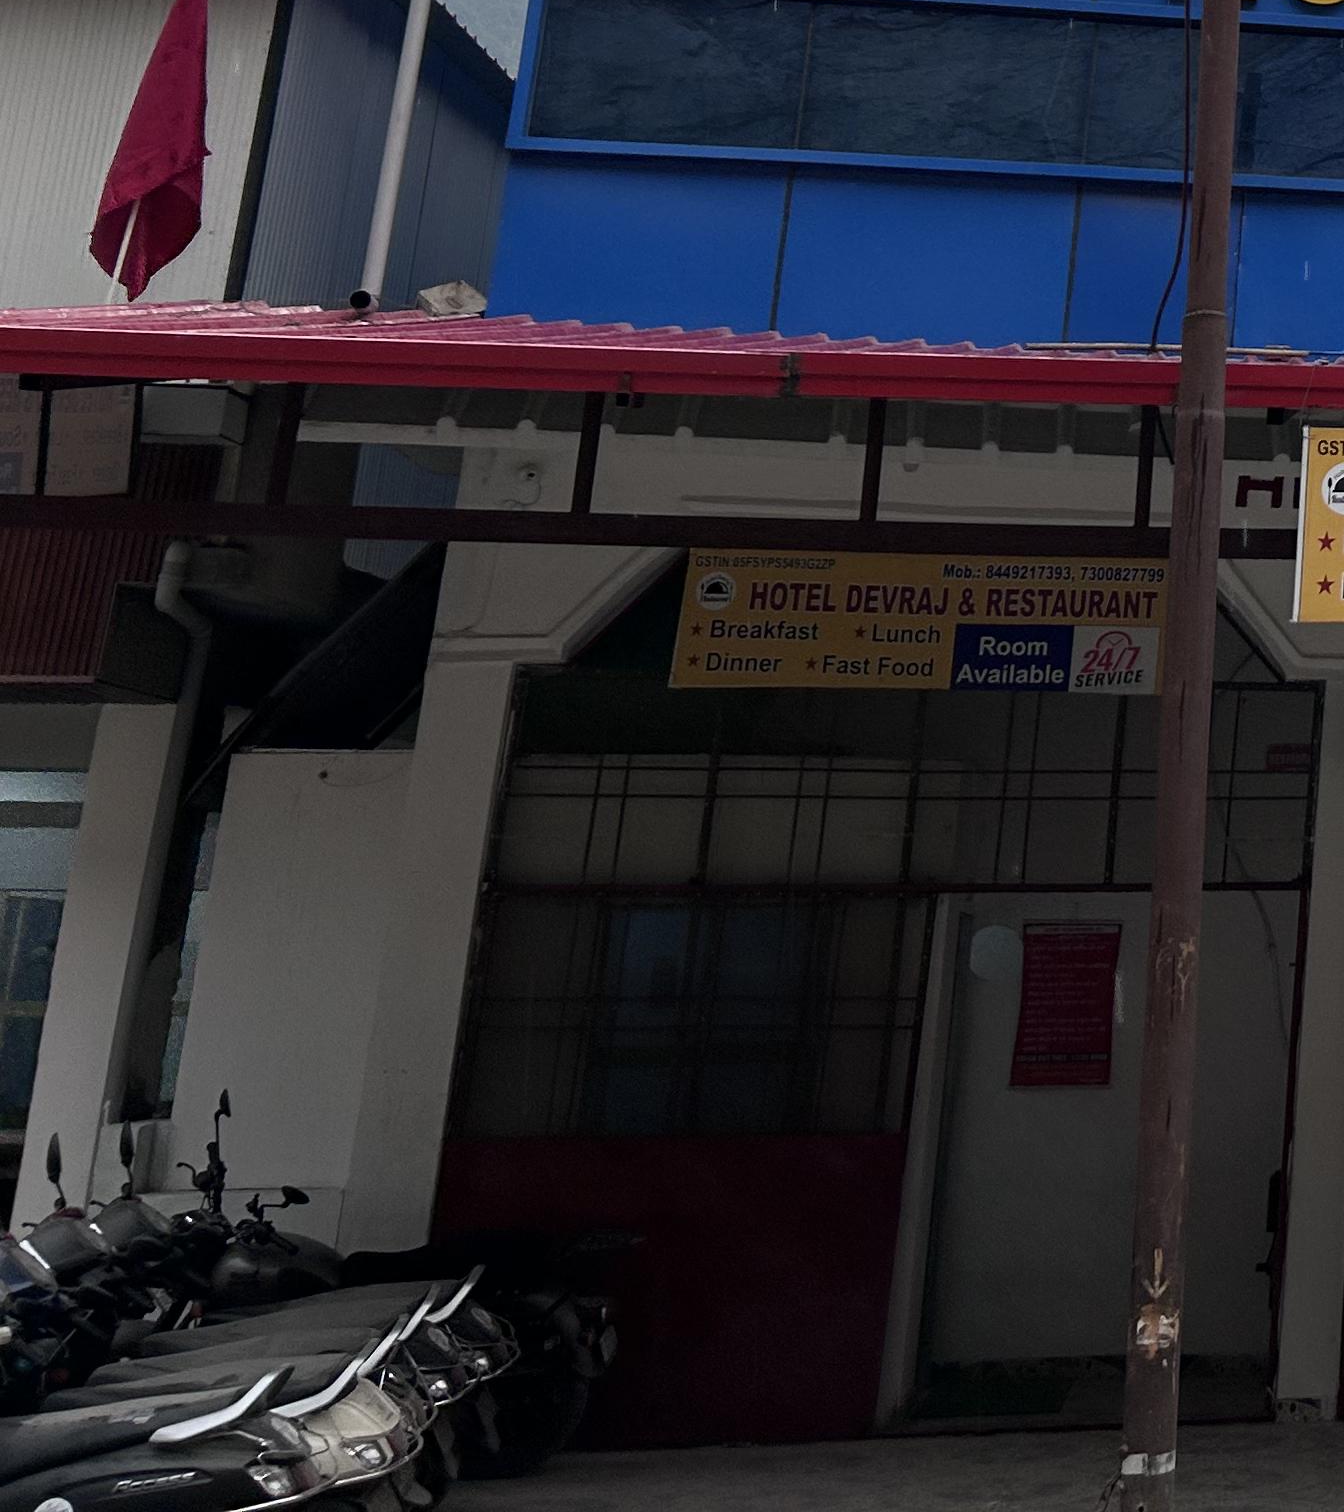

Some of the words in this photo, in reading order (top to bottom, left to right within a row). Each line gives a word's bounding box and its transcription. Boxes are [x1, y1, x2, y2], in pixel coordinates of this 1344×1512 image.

[943, 564, 981, 579] Mob.:
[985, 564, 1075, 582] 8449217393,
[1079, 566, 1165, 583] 7300827799
[749, 581, 836, 613] HOTEL
[846, 584, 949, 615] DEVRAJ
[958, 587, 975, 616] &
[986, 588, 1158, 619] RESTAURANT
[710, 620, 818, 640] Breakfast
[871, 623, 941, 643] Lunch
[977, 635, 1048, 656] Room
[706, 652, 782, 672] Dinner
[822, 655, 870, 675] Fast
[877, 657, 934, 677] Food
[1081, 646, 1141, 673] 24/7
[955, 663, 1065, 685] Available
[1074, 669, 1143, 687] SERVICE
